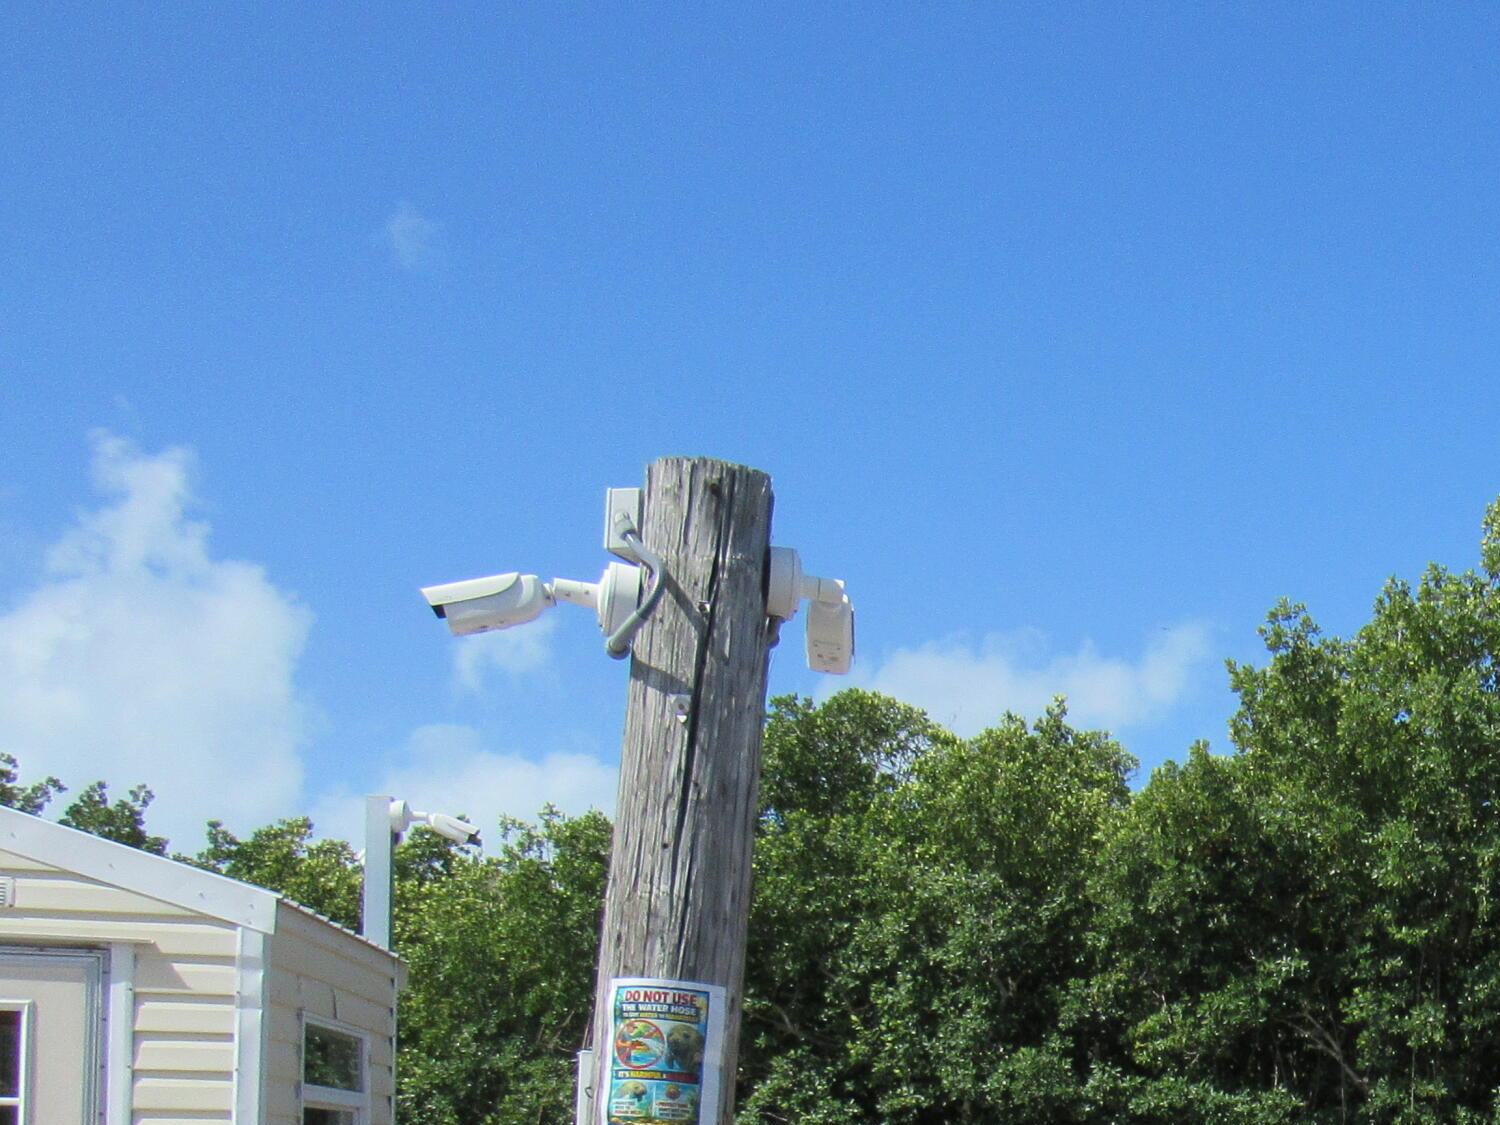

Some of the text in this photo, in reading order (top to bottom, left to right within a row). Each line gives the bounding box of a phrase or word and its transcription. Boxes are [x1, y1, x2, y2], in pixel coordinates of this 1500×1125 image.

[625, 990, 697, 1005] DO NOT USE
[670, 1007, 696, 1016] HOSE
